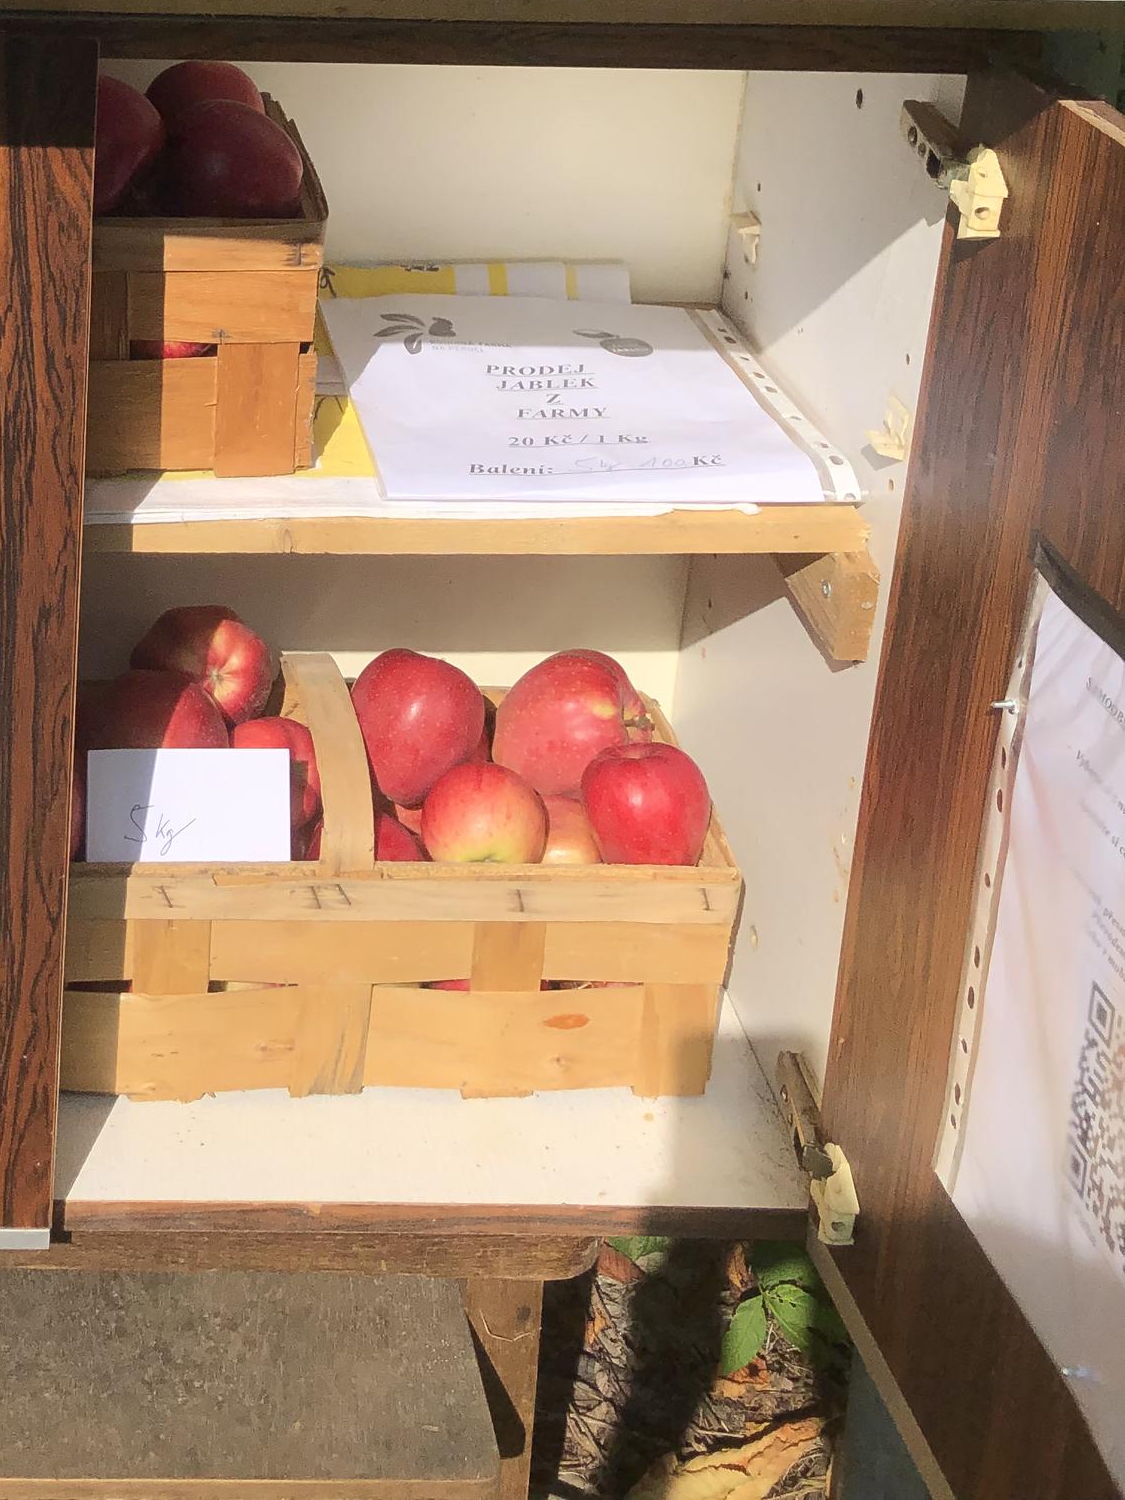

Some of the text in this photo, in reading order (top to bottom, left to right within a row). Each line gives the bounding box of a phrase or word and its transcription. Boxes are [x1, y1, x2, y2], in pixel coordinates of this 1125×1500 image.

[485, 364, 585, 376] PRODEJ
[496, 378, 596, 390] JABLEK
[546, 393, 562, 404] Z
[518, 407, 607, 419] FARMY
[508, 436, 534, 447] 20
[692, 453, 722, 467] Kč
